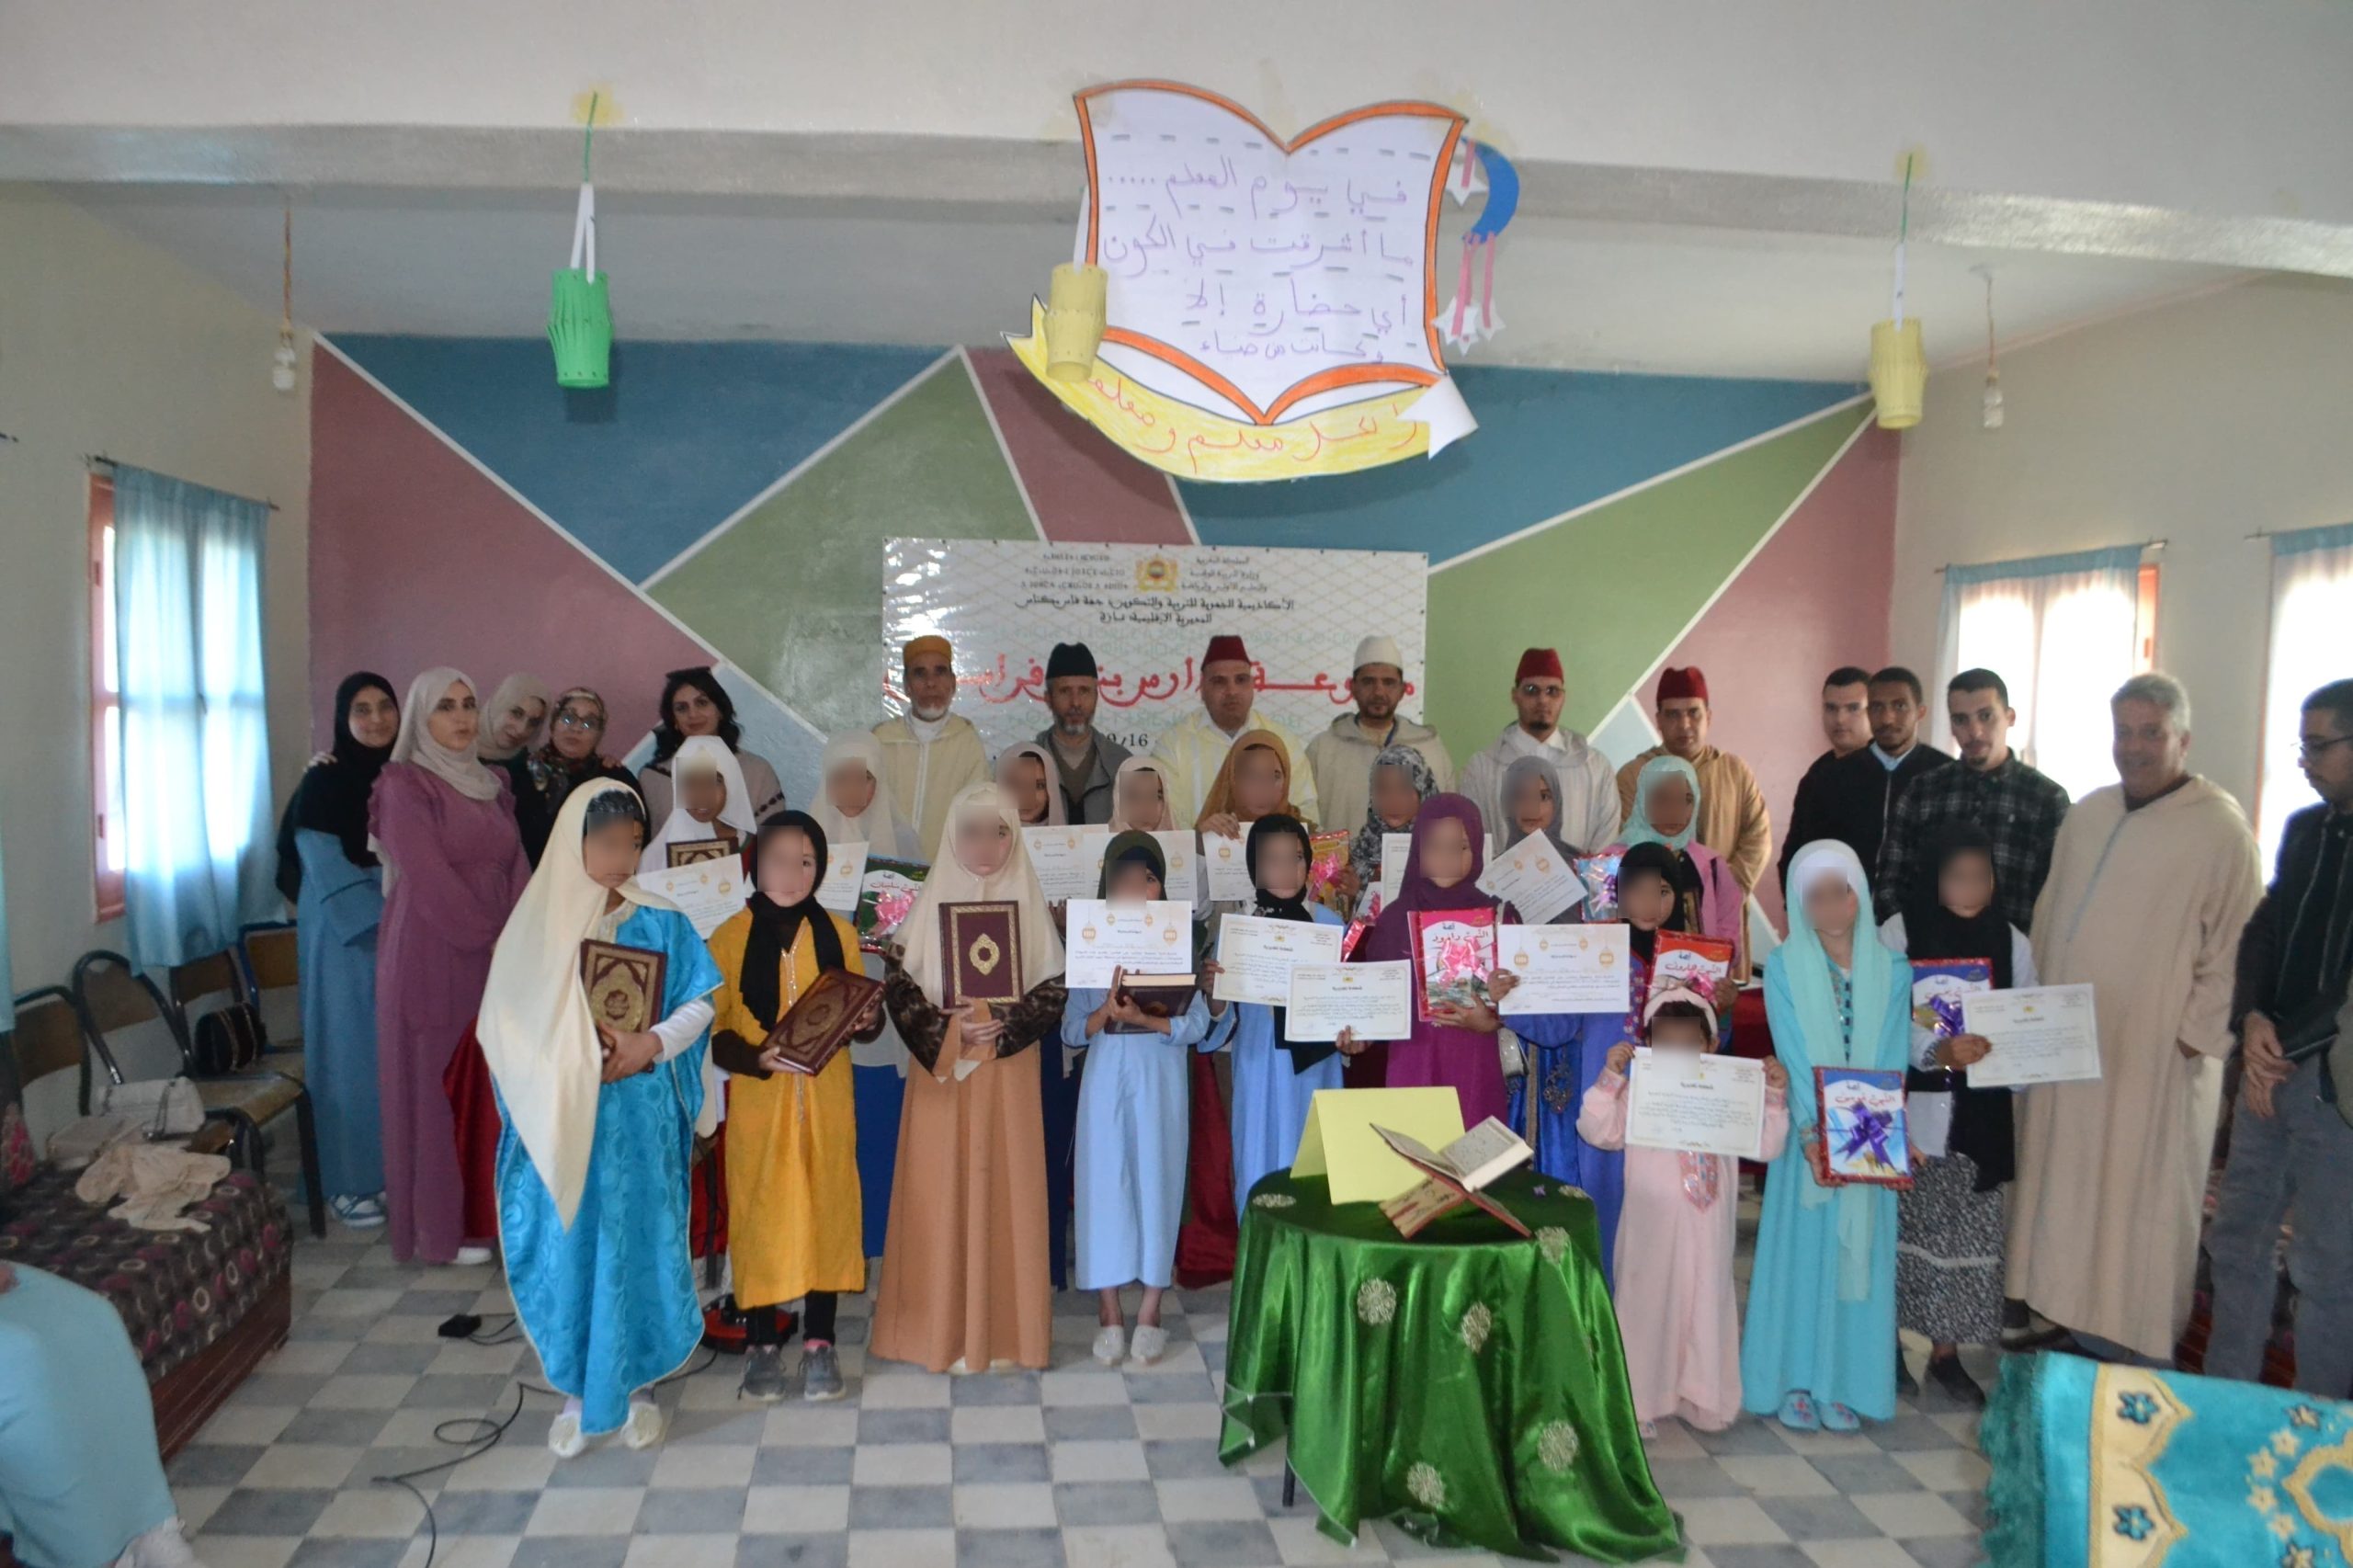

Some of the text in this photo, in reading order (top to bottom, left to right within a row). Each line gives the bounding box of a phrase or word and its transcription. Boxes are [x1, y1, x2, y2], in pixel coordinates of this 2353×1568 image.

[1165, 154, 1237, 220] المعلم
[1251, 176, 1329, 221] يوم
[1347, 178, 1407, 215] في
[1103, 213, 1176, 278] الكون
[1186, 229, 1236, 267] في
[1380, 233, 1414, 266] ما
[1248, 277, 1361, 336] حضارة
[1370, 294, 1407, 335] أي
[1188, 428, 1283, 475] معلم
[1293, 415, 1377, 461] لكل
[1176, 613, 1212, 627] المديرية
[1200, 597, 1234, 610] الجهوية
